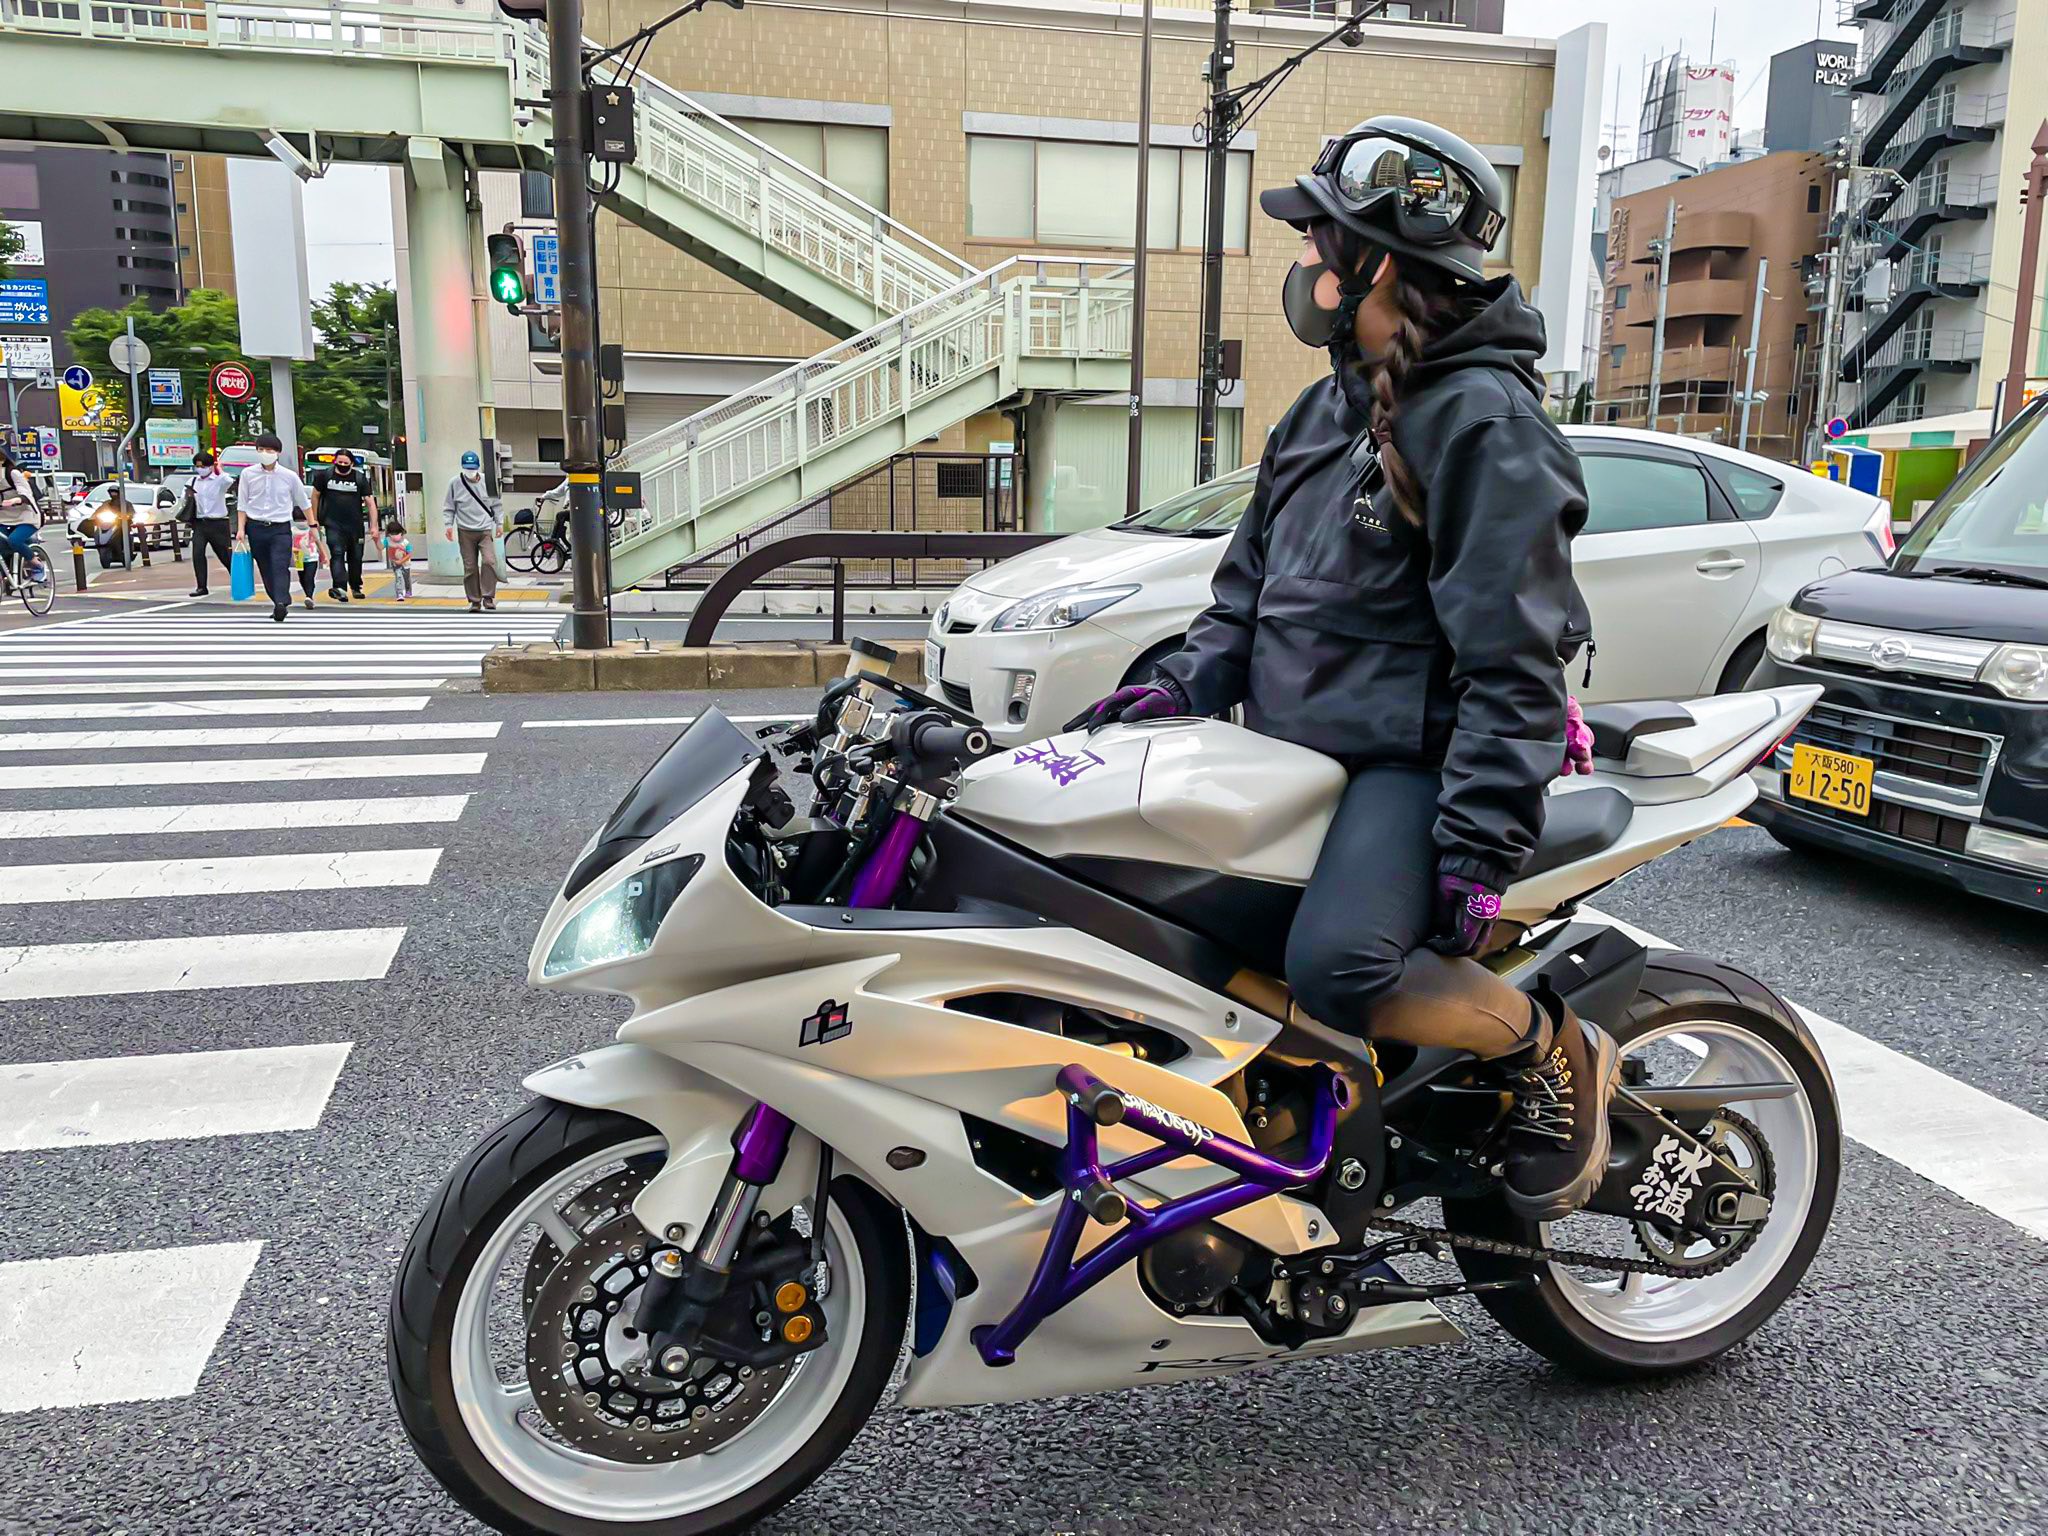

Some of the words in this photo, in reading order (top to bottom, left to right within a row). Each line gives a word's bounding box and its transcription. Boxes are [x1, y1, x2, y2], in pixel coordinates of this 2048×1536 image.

[1688, 67, 1717, 80] マリオ
[1815, 69, 1853, 86] PLAZ
[1682, 108, 1716, 120] プラザ
[5, 351, 51, 361] クリニック
[220, 376, 246, 389] 消火栓
[1810, 770, 1866, 810] 12-50
